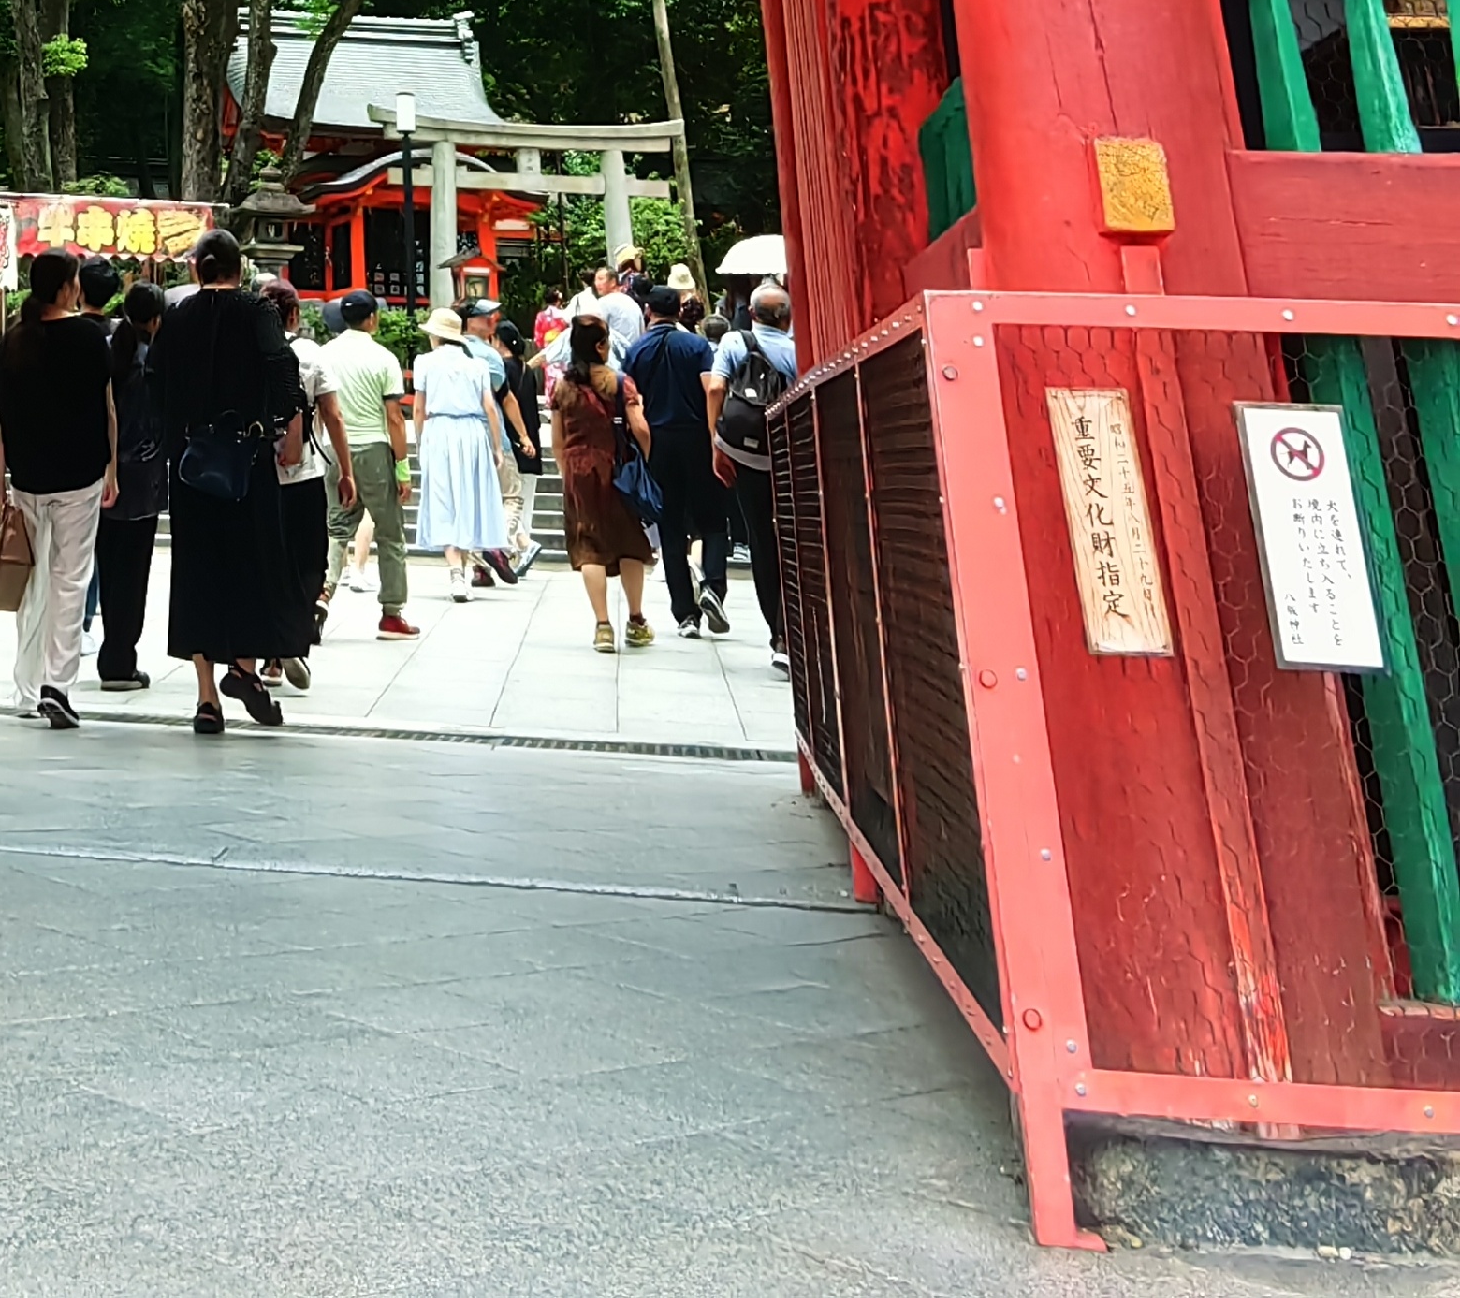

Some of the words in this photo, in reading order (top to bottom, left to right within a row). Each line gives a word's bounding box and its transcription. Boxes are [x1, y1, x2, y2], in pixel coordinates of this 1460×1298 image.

[1072, 415, 1131, 618] 重要文化財指定
